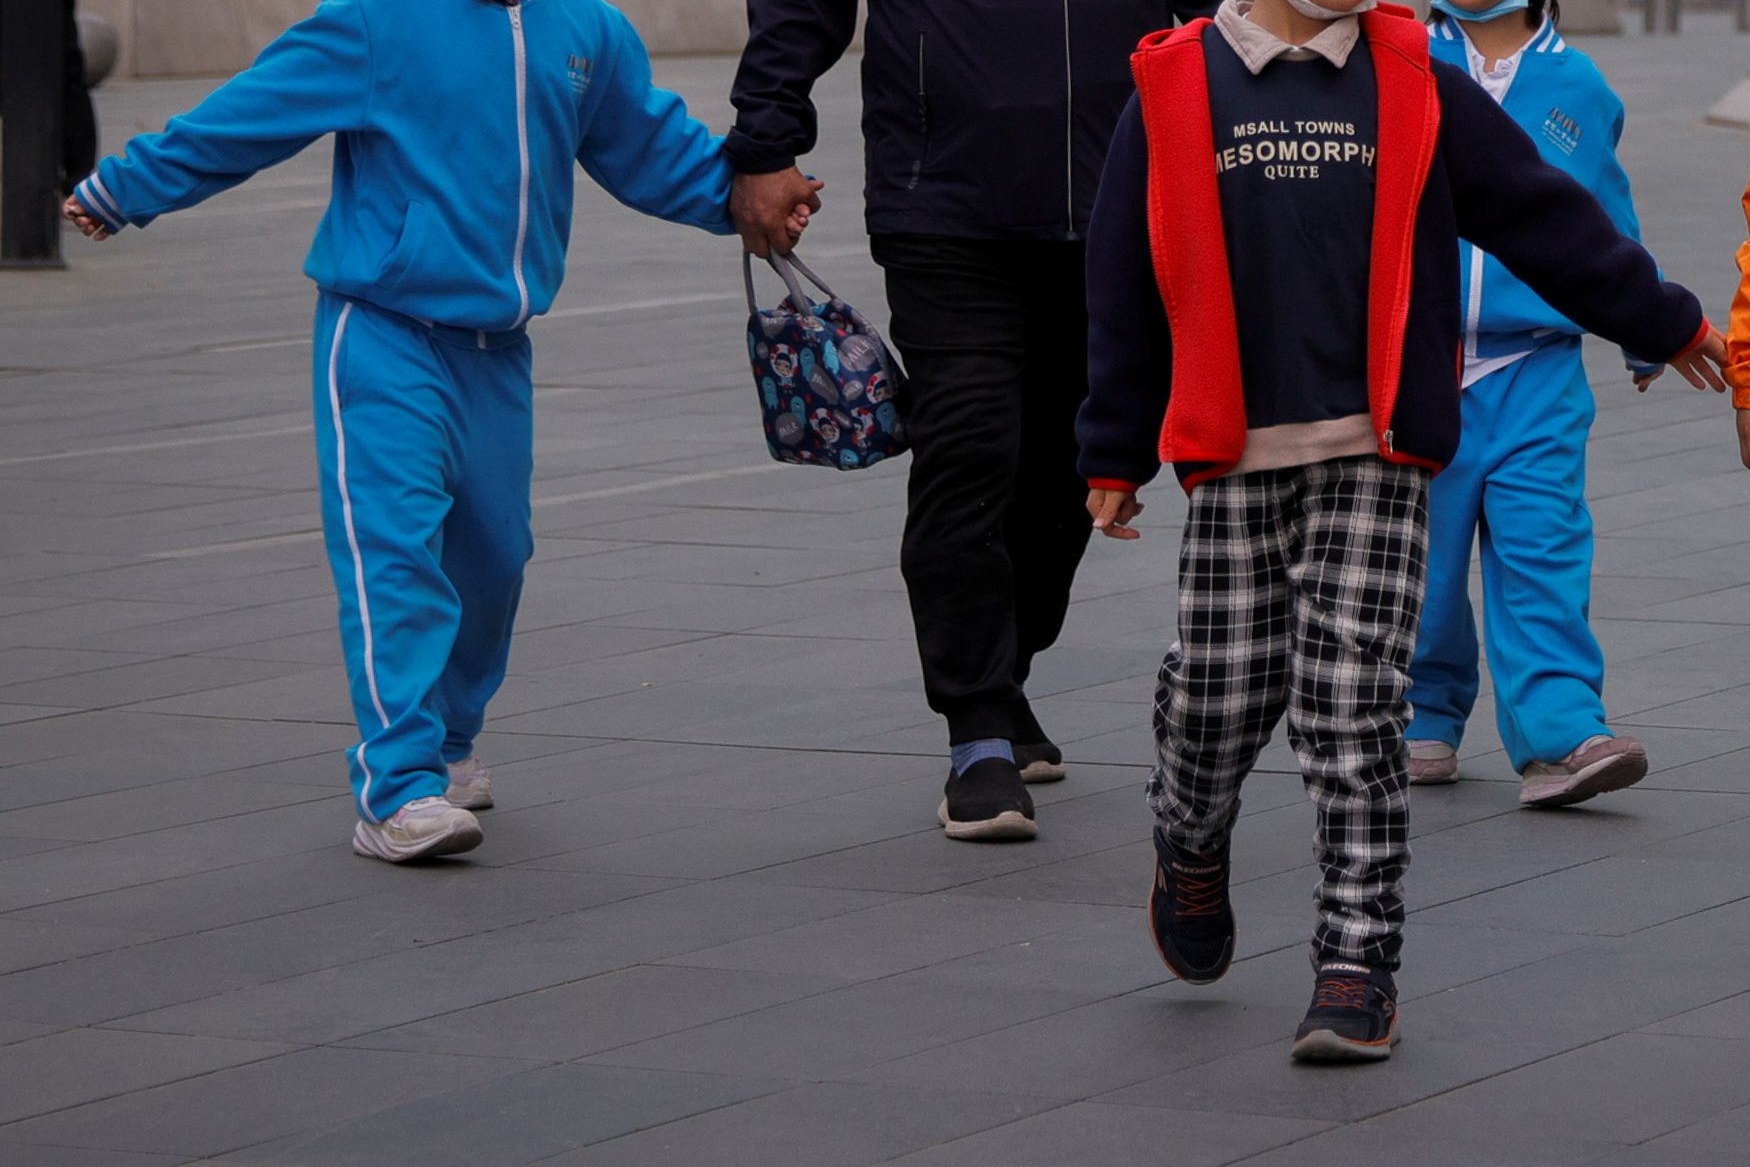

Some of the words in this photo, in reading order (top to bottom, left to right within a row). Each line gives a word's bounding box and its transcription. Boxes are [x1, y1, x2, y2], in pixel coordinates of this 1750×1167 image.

[1233, 120, 1290, 139] MSALL
[1294, 120, 1356, 136] TOWNS
[1264, 165, 1320, 180] QUITE
